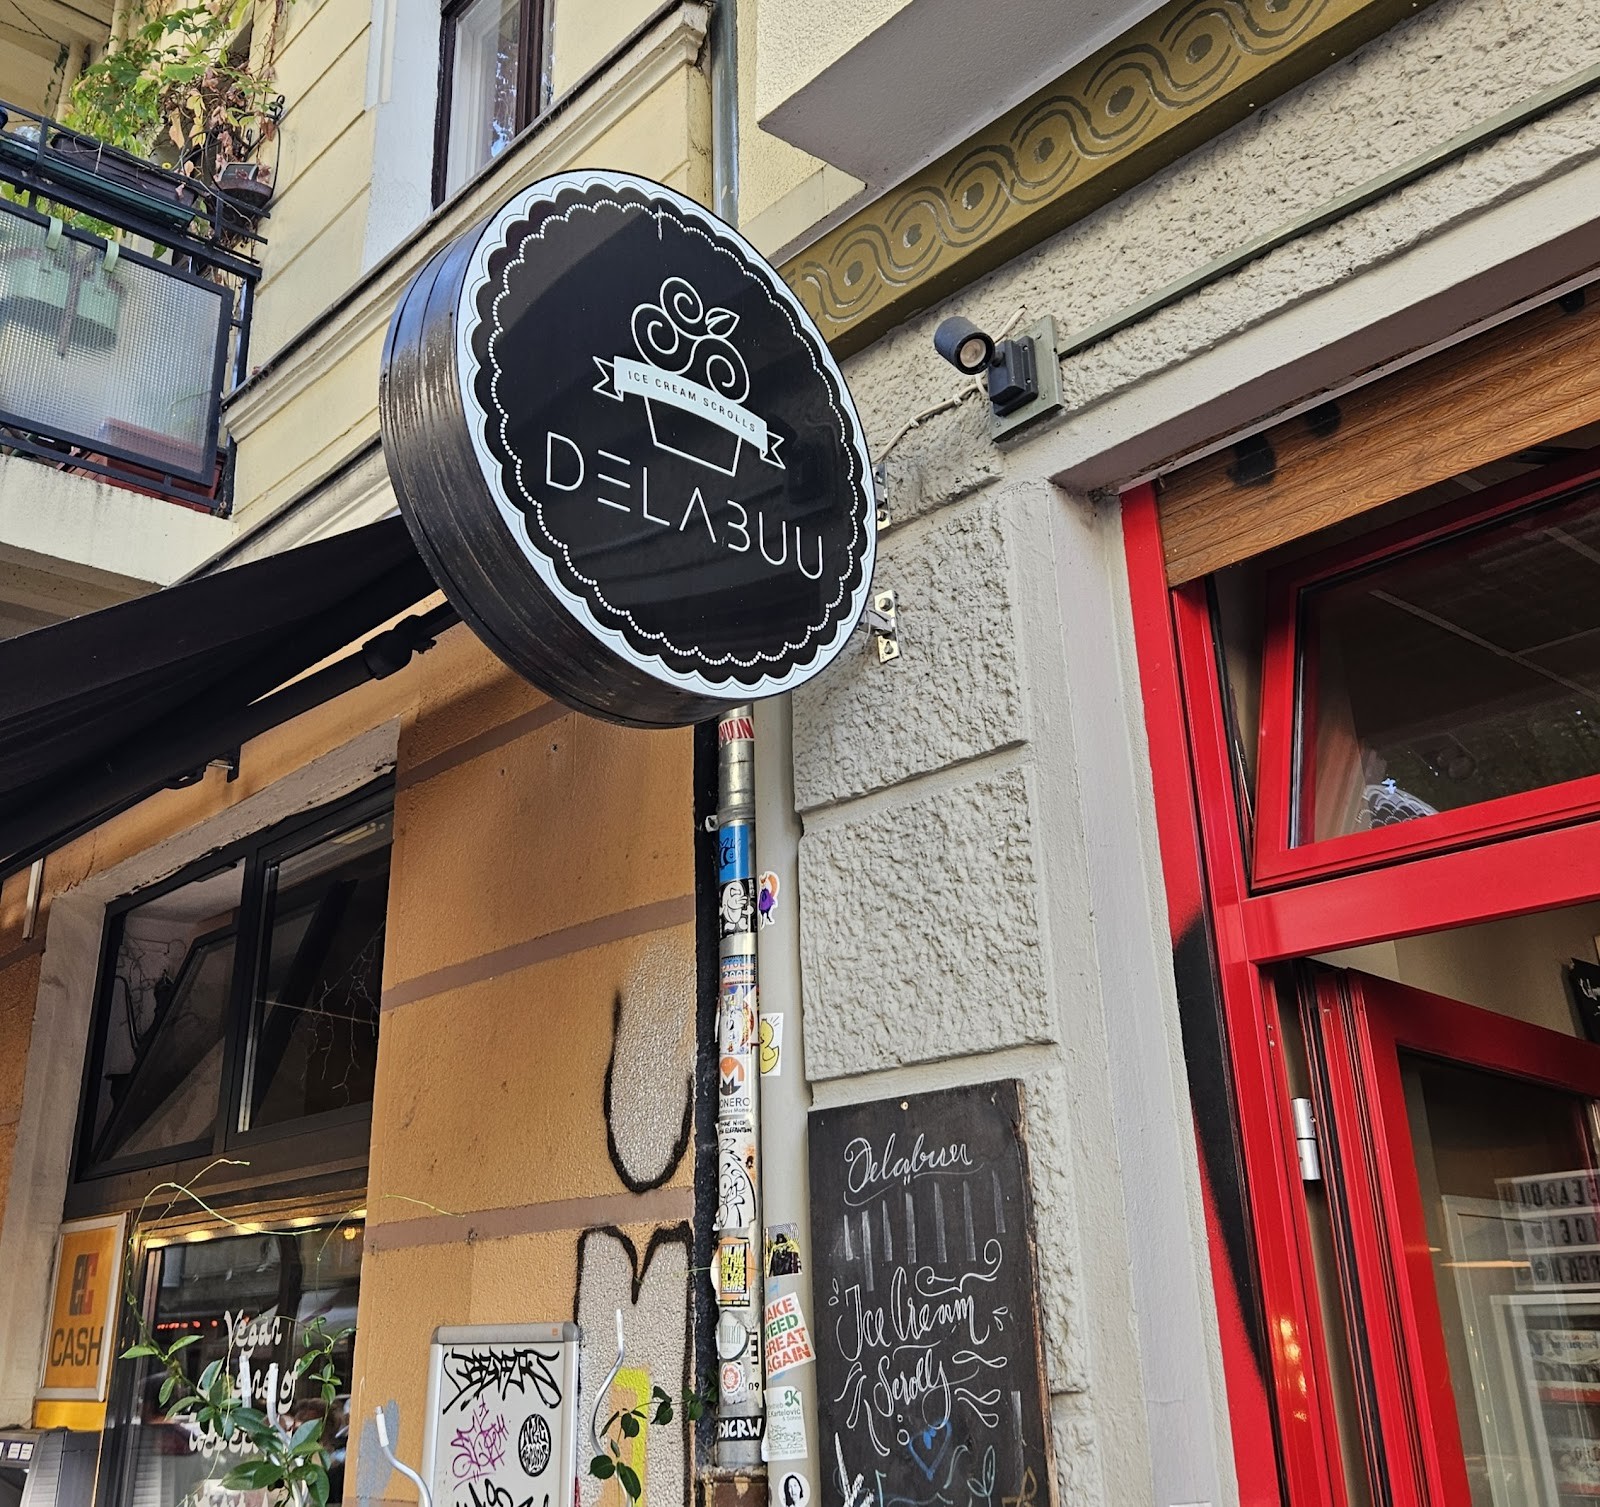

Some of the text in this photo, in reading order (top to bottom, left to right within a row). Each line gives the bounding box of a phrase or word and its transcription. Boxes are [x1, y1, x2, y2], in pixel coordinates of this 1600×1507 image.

[627, 370, 756, 432] ICE CREAM SCROLLS
[545, 431, 824, 580] DELABUU
[719, 1097, 750, 1109] ONERO
[223, 1308, 283, 1359] Vegan
[766, 1298, 795, 1324] AKE
[51, 1326, 103, 1367] CASH
